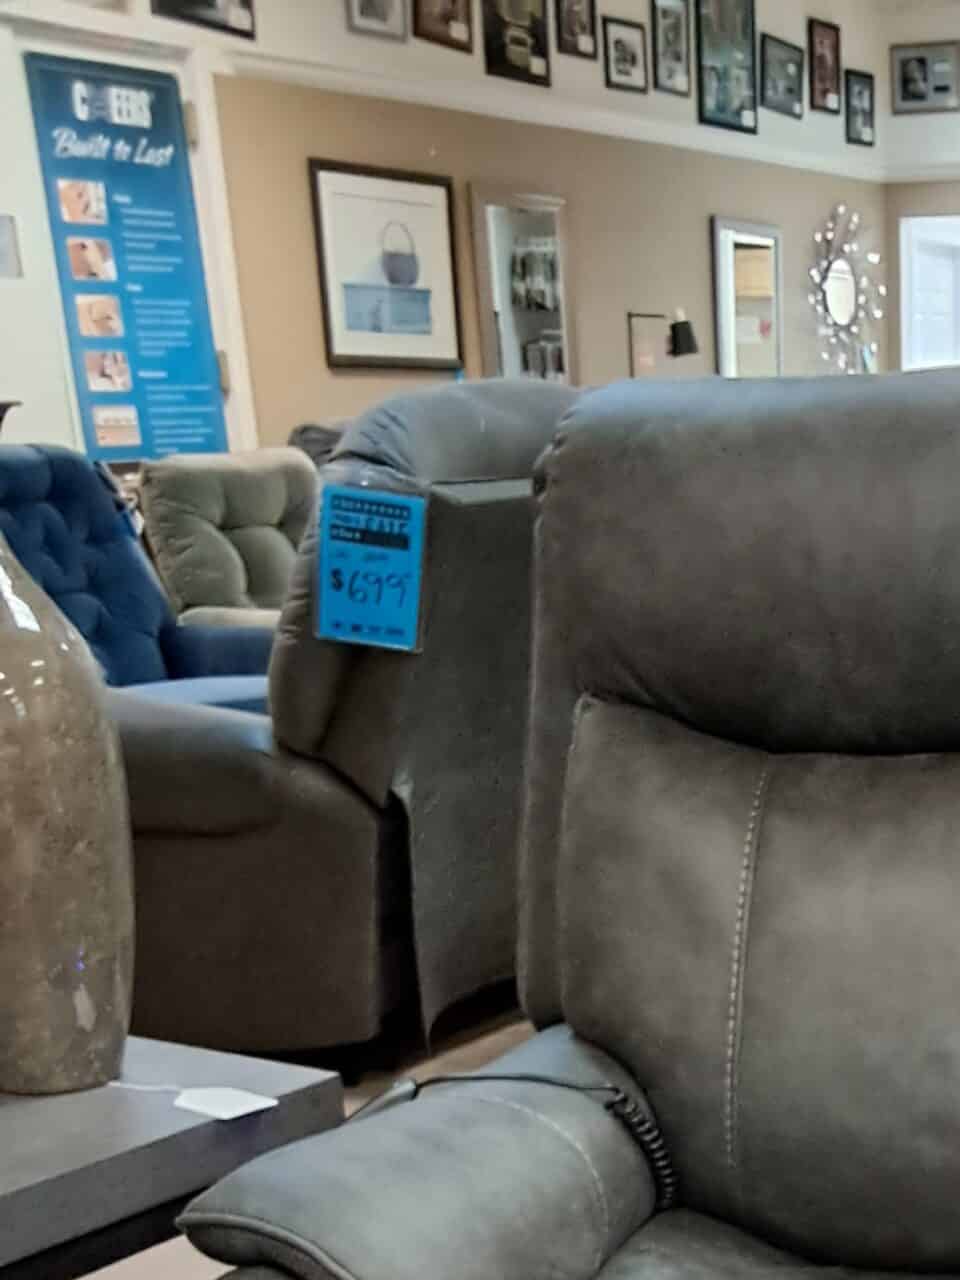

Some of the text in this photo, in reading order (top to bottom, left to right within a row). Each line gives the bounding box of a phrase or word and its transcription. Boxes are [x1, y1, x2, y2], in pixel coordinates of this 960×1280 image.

[53, 127, 174, 167] Built to Last
